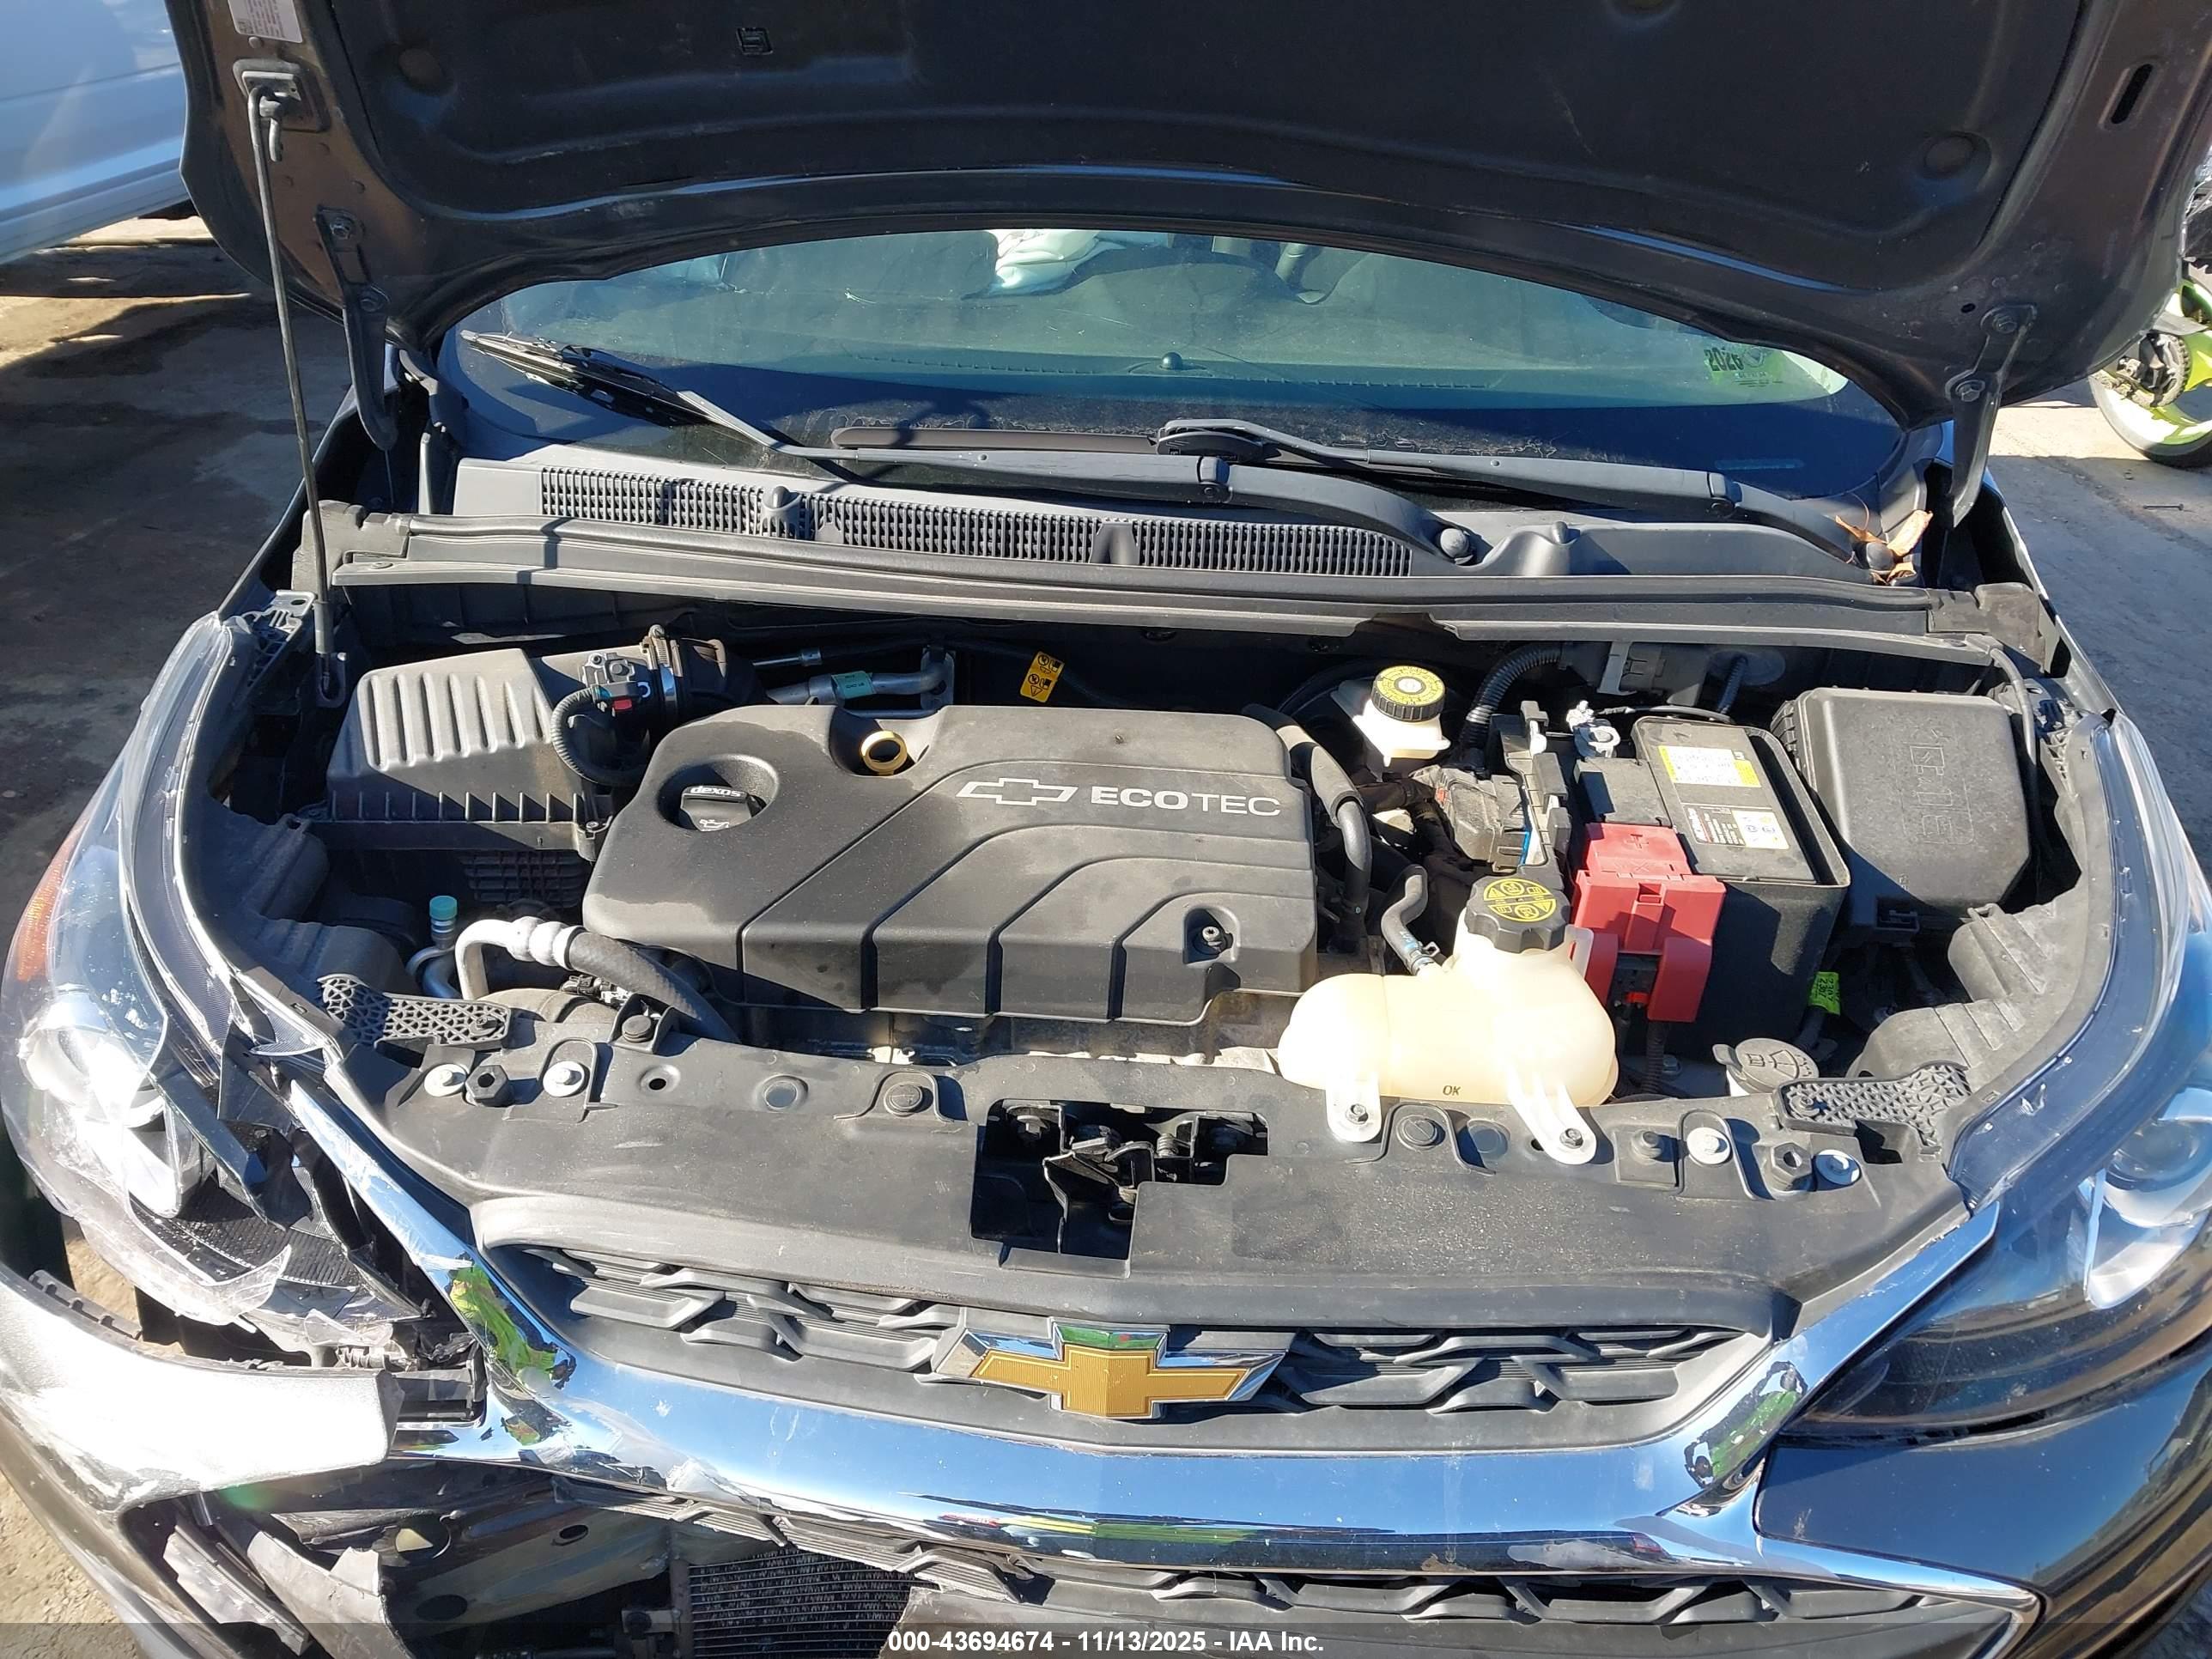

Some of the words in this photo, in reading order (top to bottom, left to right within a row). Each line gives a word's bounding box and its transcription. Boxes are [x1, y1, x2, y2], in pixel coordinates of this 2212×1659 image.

[1704, 347, 1744, 371] 2026
[690, 785, 742, 798] dexos
[1090, 785, 1281, 817] ECOTEC
[1443, 1085, 1461, 1096] OK
